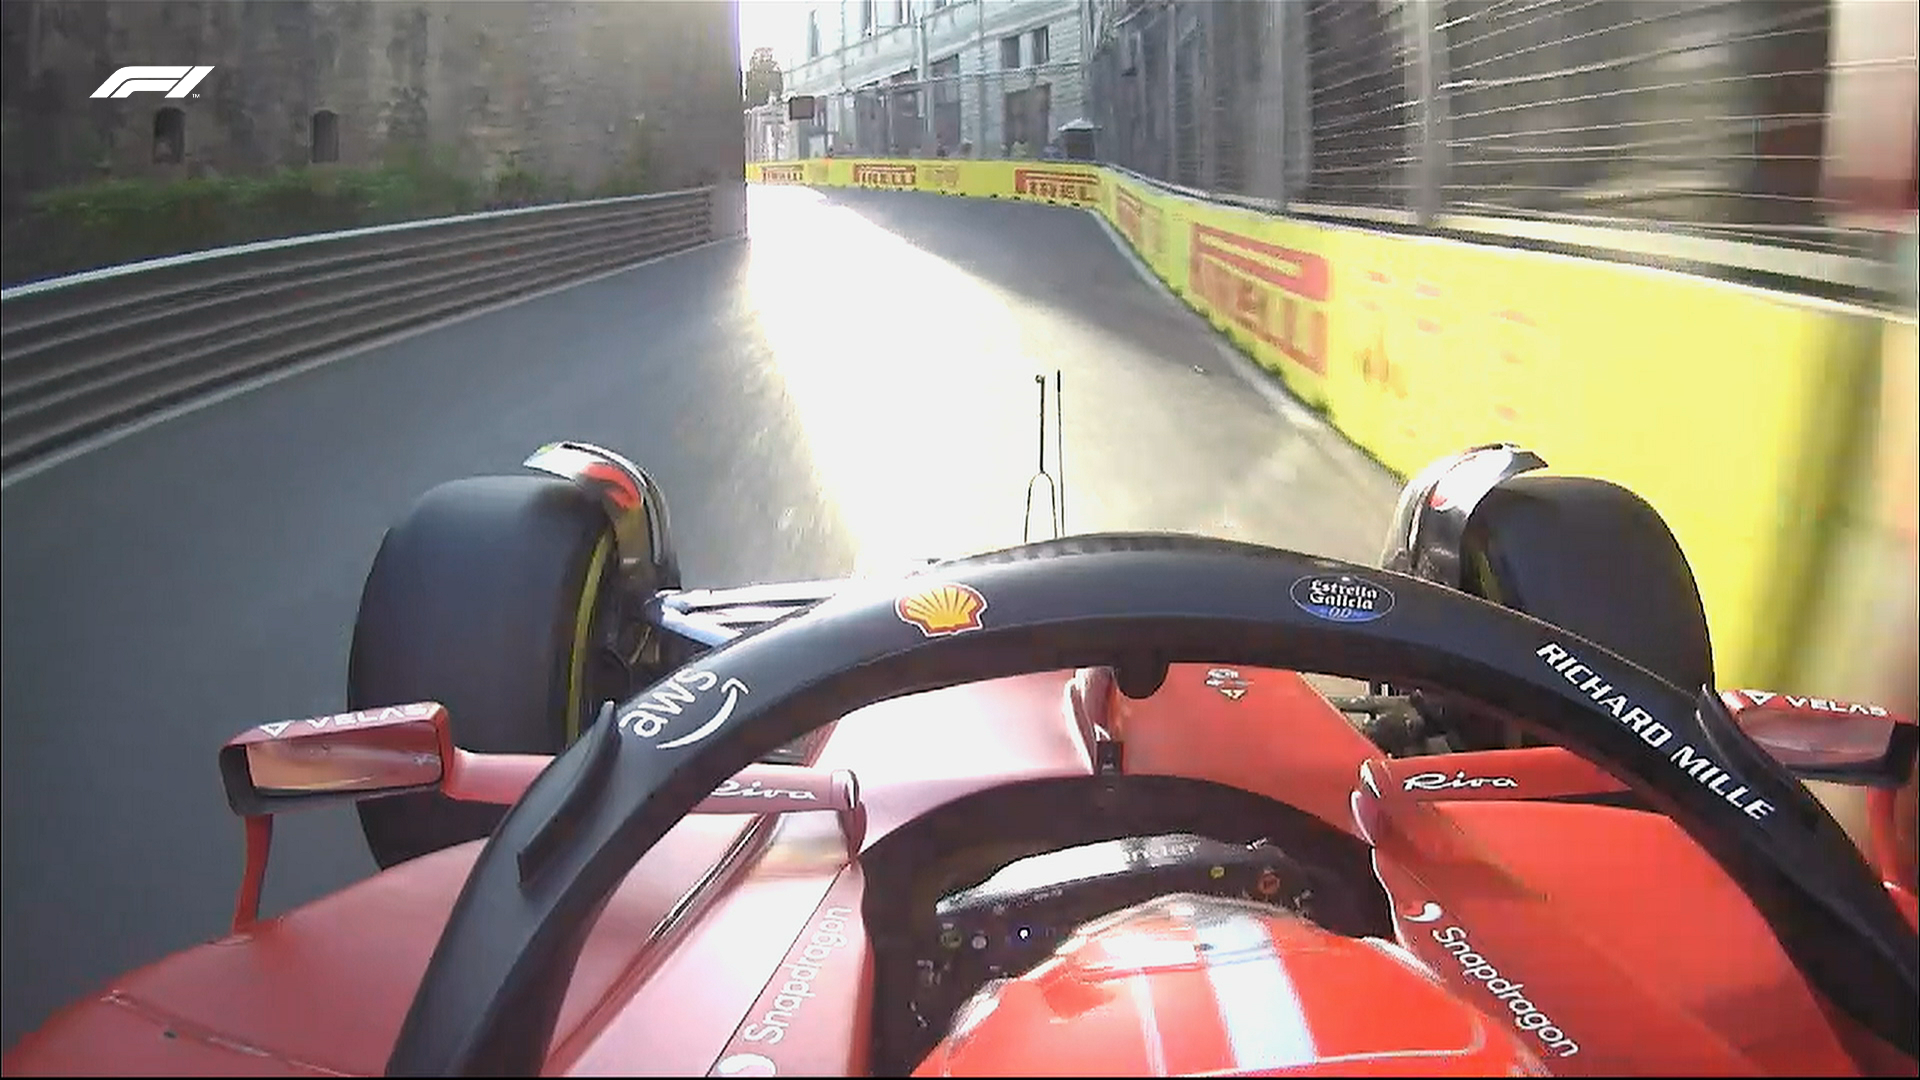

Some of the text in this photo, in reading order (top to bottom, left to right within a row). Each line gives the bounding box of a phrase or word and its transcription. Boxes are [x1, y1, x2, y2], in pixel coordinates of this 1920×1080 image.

[1309, 592, 1373, 610] Galicia
[1310, 579, 1377, 599] Estrella
[306, 702, 429, 729] VELAS
[619, 668, 717, 737] aws
[1537, 643, 1775, 820] RICHARD MILLE
[1403, 771, 1518, 791] Riva
[743, 905, 852, 1045] Snapdragon
[1432, 926, 1579, 1057] Snapdragon
